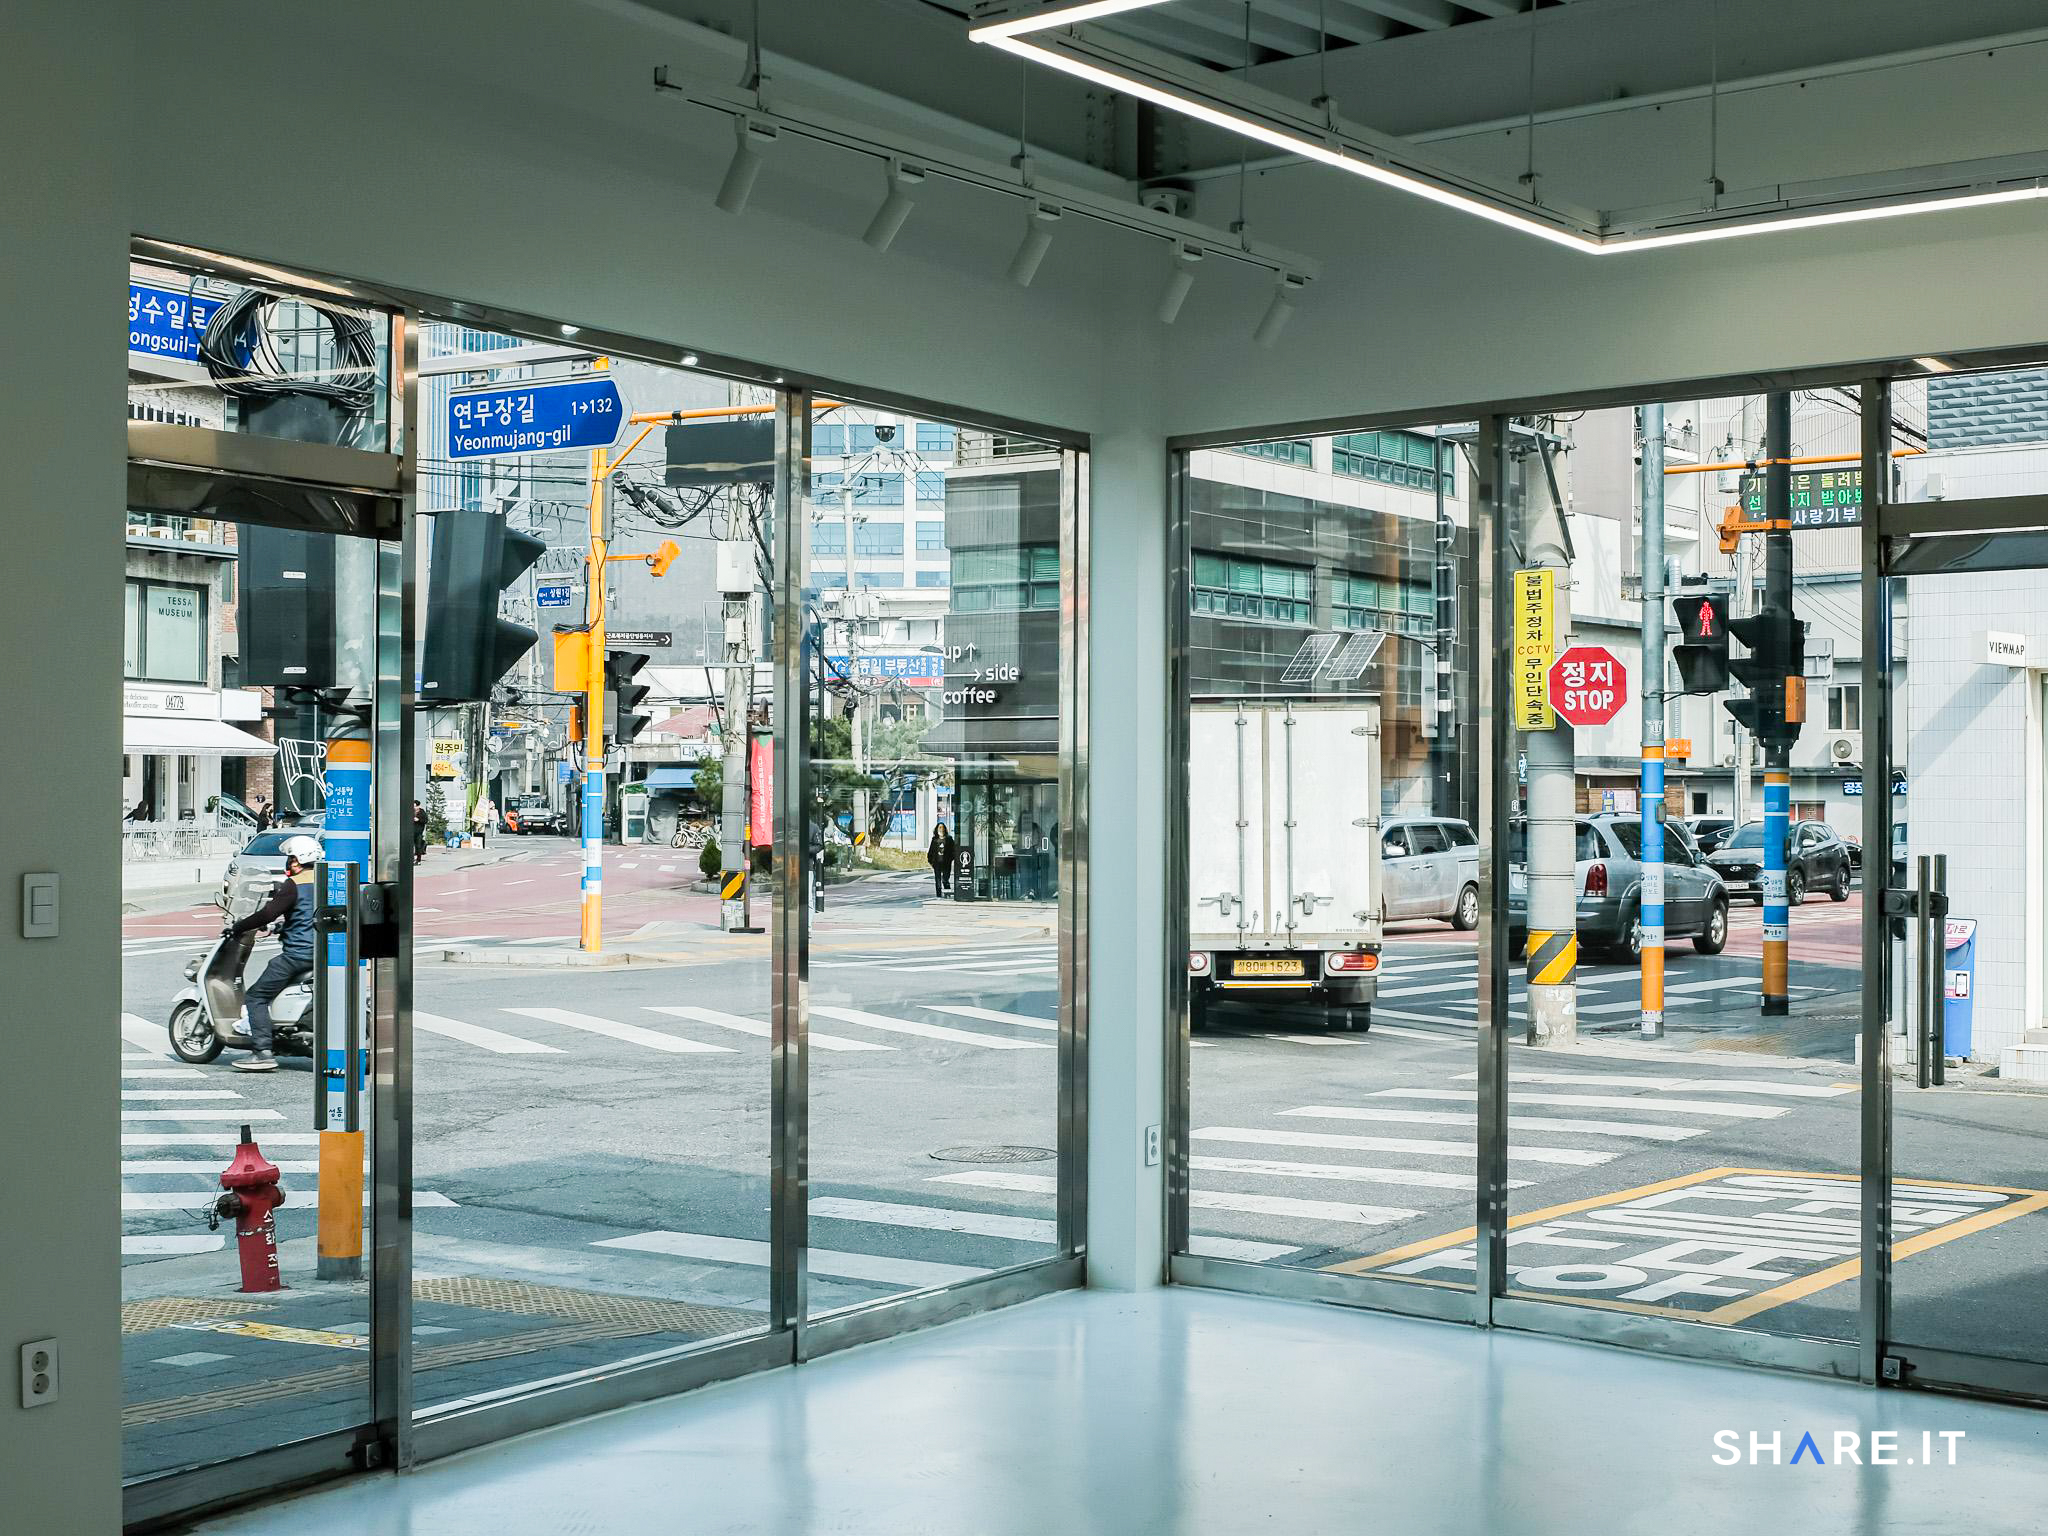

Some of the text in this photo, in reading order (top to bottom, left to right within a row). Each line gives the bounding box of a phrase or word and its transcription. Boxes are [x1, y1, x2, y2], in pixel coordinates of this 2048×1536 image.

[453, 394, 535, 430] 연무장길
[454, 425, 572, 452] Yeonmujang-gil
[167, 596, 193, 607] TESSA
[158, 607, 193, 618] MUSEUM
[1518, 575, 1551, 725] 불법주정차 CCTV 무인단속중
[1989, 641, 2025, 656] VIEWMAP
[885, 658, 920, 675] 부동산
[985, 663, 1019, 682] side
[1562, 661, 1613, 688] 정지
[943, 686, 996, 705] coffee
[1564, 690, 1614, 711] STOP
[435, 743, 462, 754] 원주민
[330, 797, 354, 806] 스마트
[1270, 961, 1298, 973] 1523
